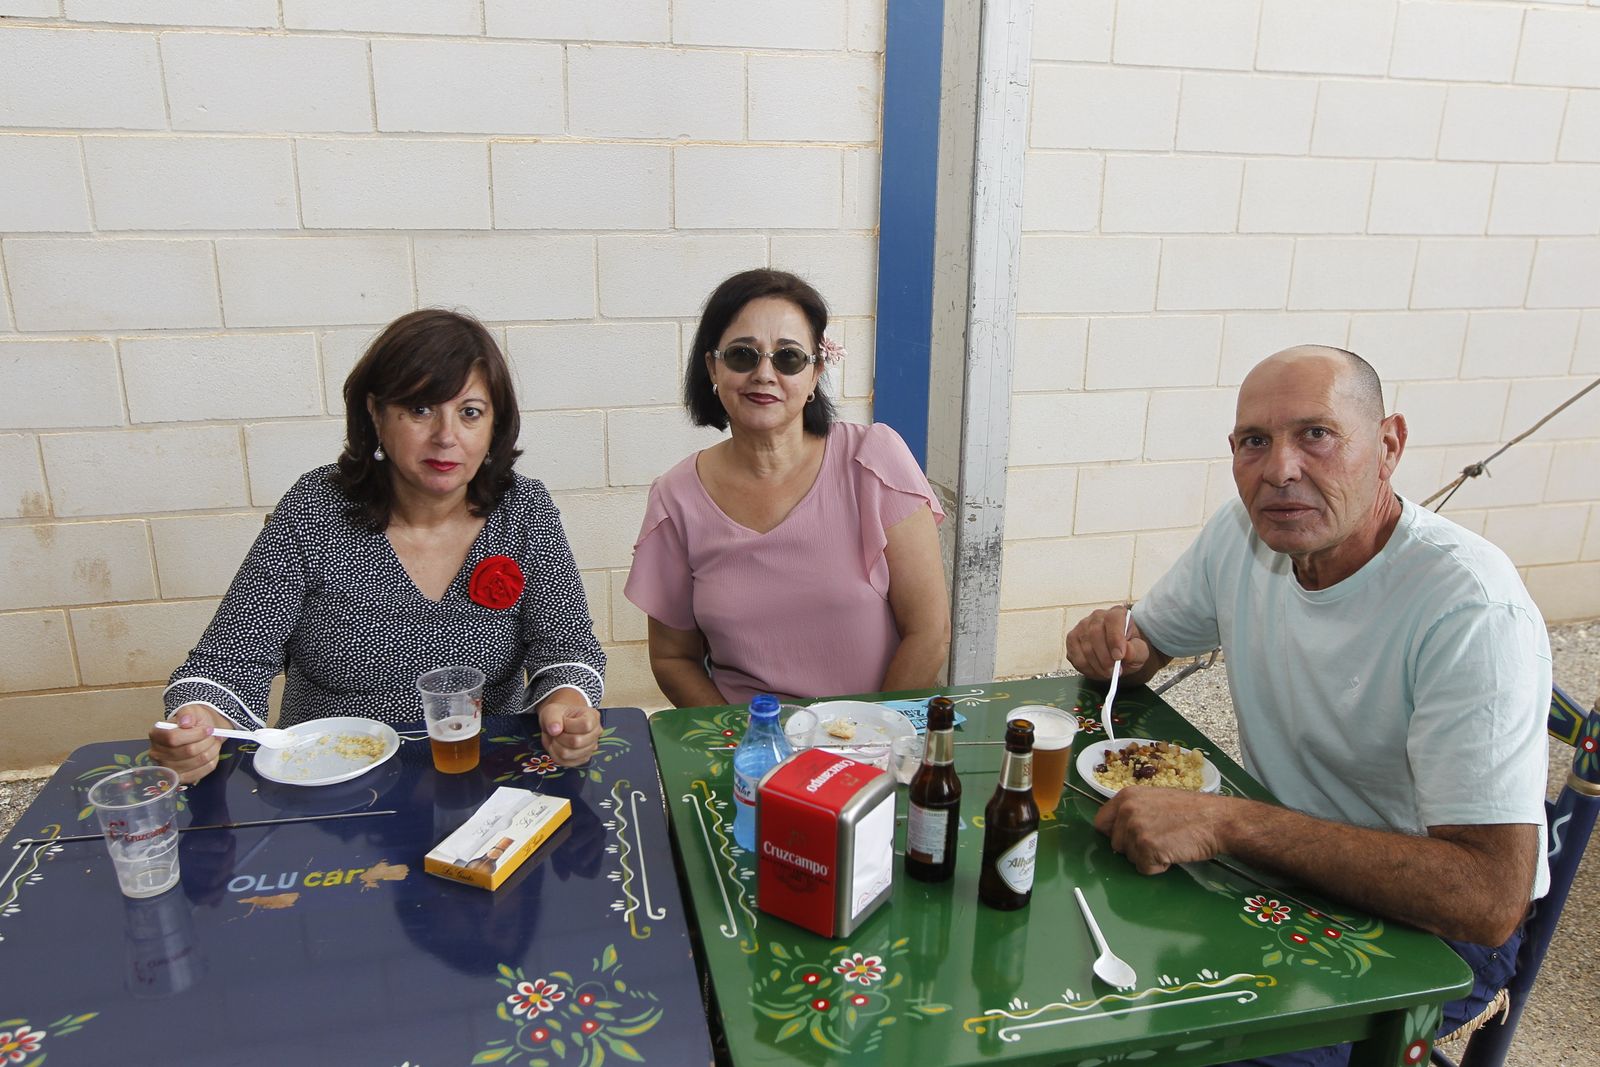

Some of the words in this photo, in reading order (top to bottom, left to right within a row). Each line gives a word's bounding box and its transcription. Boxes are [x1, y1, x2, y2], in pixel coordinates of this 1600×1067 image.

[806, 759, 856, 793] Cruzcampo
[763, 840, 829, 876] Cruzcampo
[227, 871, 299, 893] OLU
